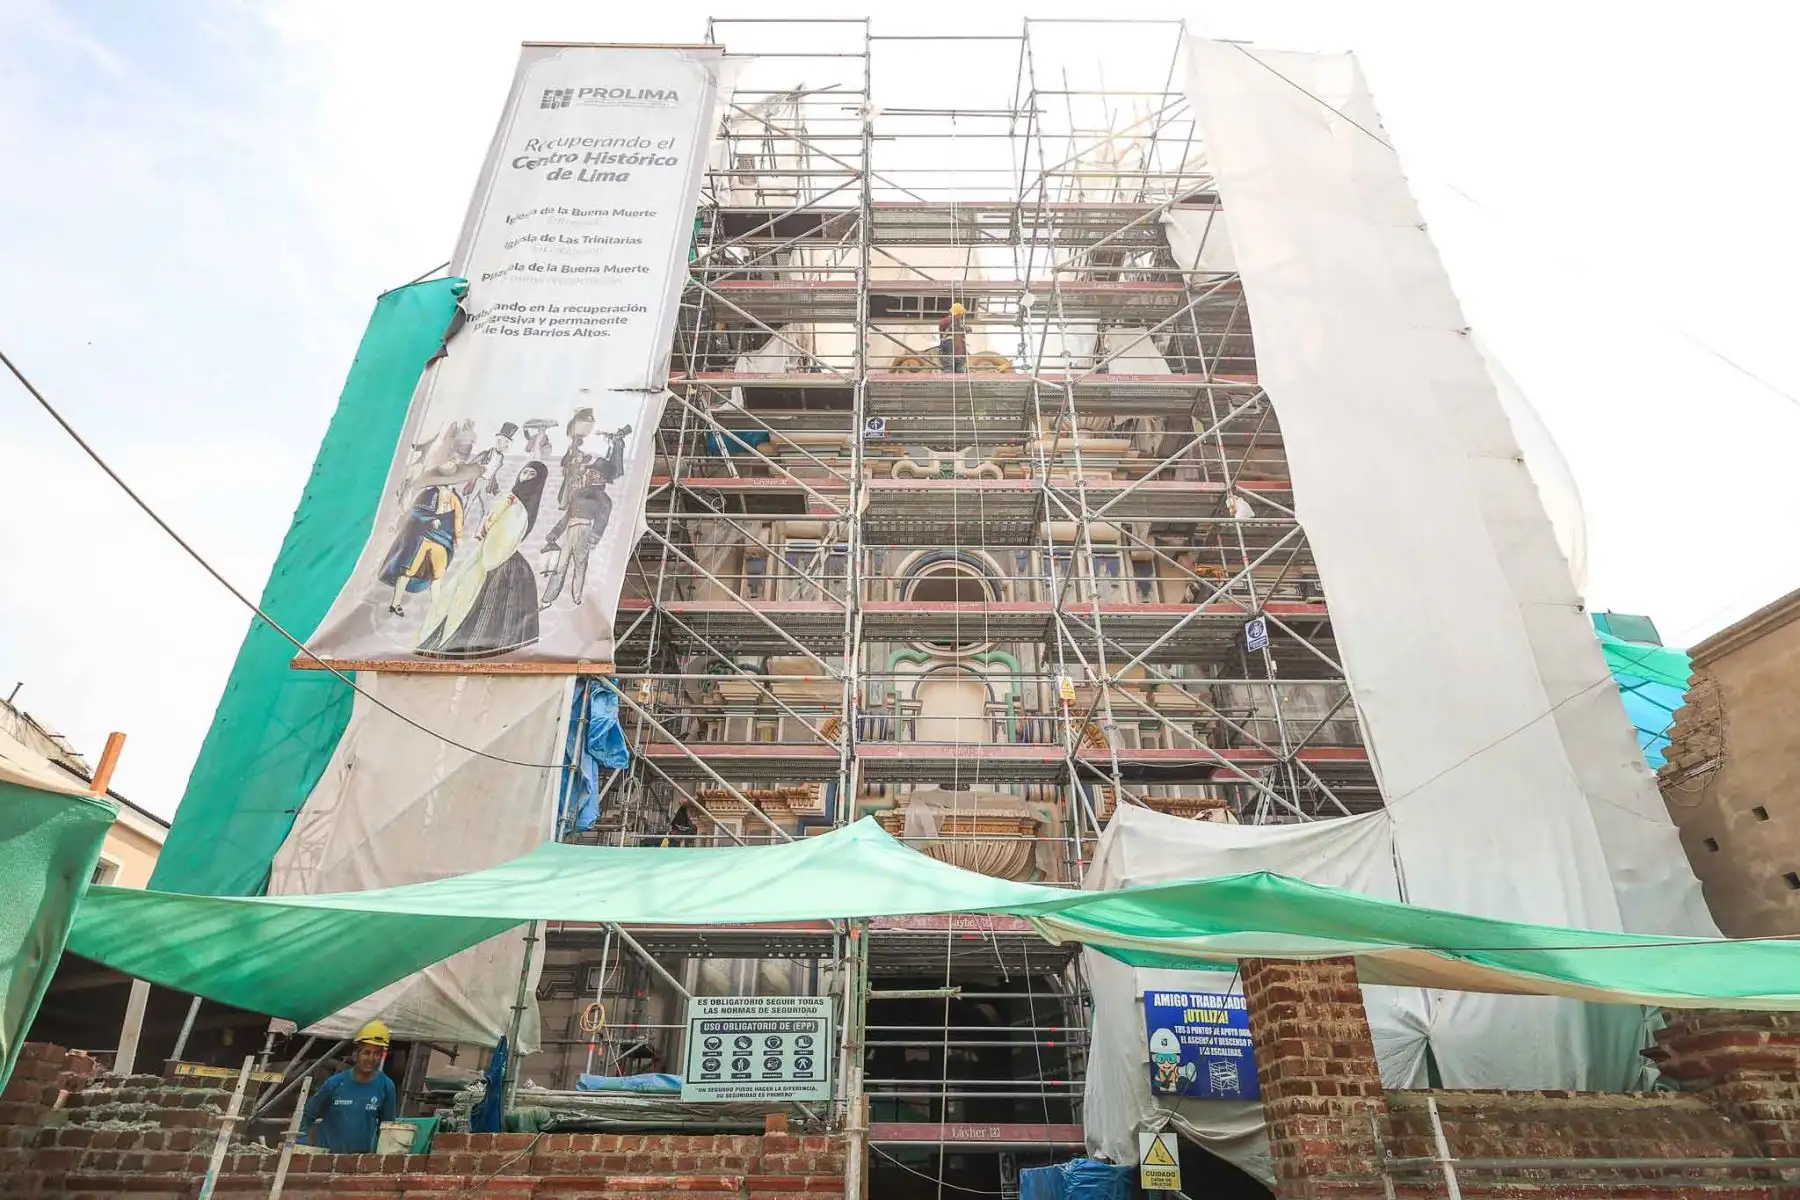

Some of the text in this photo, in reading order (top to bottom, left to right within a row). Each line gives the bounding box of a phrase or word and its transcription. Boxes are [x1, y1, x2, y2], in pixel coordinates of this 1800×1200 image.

[578, 88, 680, 101] PROLIMA
[657, 137, 675, 150] el
[512, 151, 679, 170] Centro Histórico
[546, 167, 630, 182] de Lima
[540, 206, 657, 217] de la Buena Muerte
[540, 233, 556, 242] de
[559, 234, 579, 244] Las
[582, 235, 643, 245] Trinitarias
[528, 262, 544, 272] de
[546, 263, 558, 273] la
[560, 264, 601, 274] Buena
[603, 264, 650, 274] Muerte
[529, 304, 545, 312] en
[548, 304, 560, 313] la
[563, 303, 648, 315] recuperación
[538, 316, 547, 325] y
[549, 316, 629, 327] permanente
[500, 325, 520, 337] los
[523, 327, 571, 338] Barrios
[572, 327, 611, 338] Altos.
[951, 917, 977, 928] ayhe
[698, 998, 824, 1006] ES OBLIGATORIO SEGUIR TODAS
[1154, 993, 1188, 1007] AMIGO
[703, 1022, 816, 1031] USO OBLIGATORIO DE (EPP)
[1174, 1026, 1186, 1034] TUS
[1186, 1026, 1191, 1034] 3
[1191, 1026, 1213, 1035] PUNTOS
[1221, 1028, 1239, 1036] APOYO
[1181, 1036, 1187, 1044] EL
[1219, 1038, 1246, 1047] DESCENSO
[952, 1127, 986, 1139] Layher
[1145, 1170, 1176, 1178] CUIDADO
